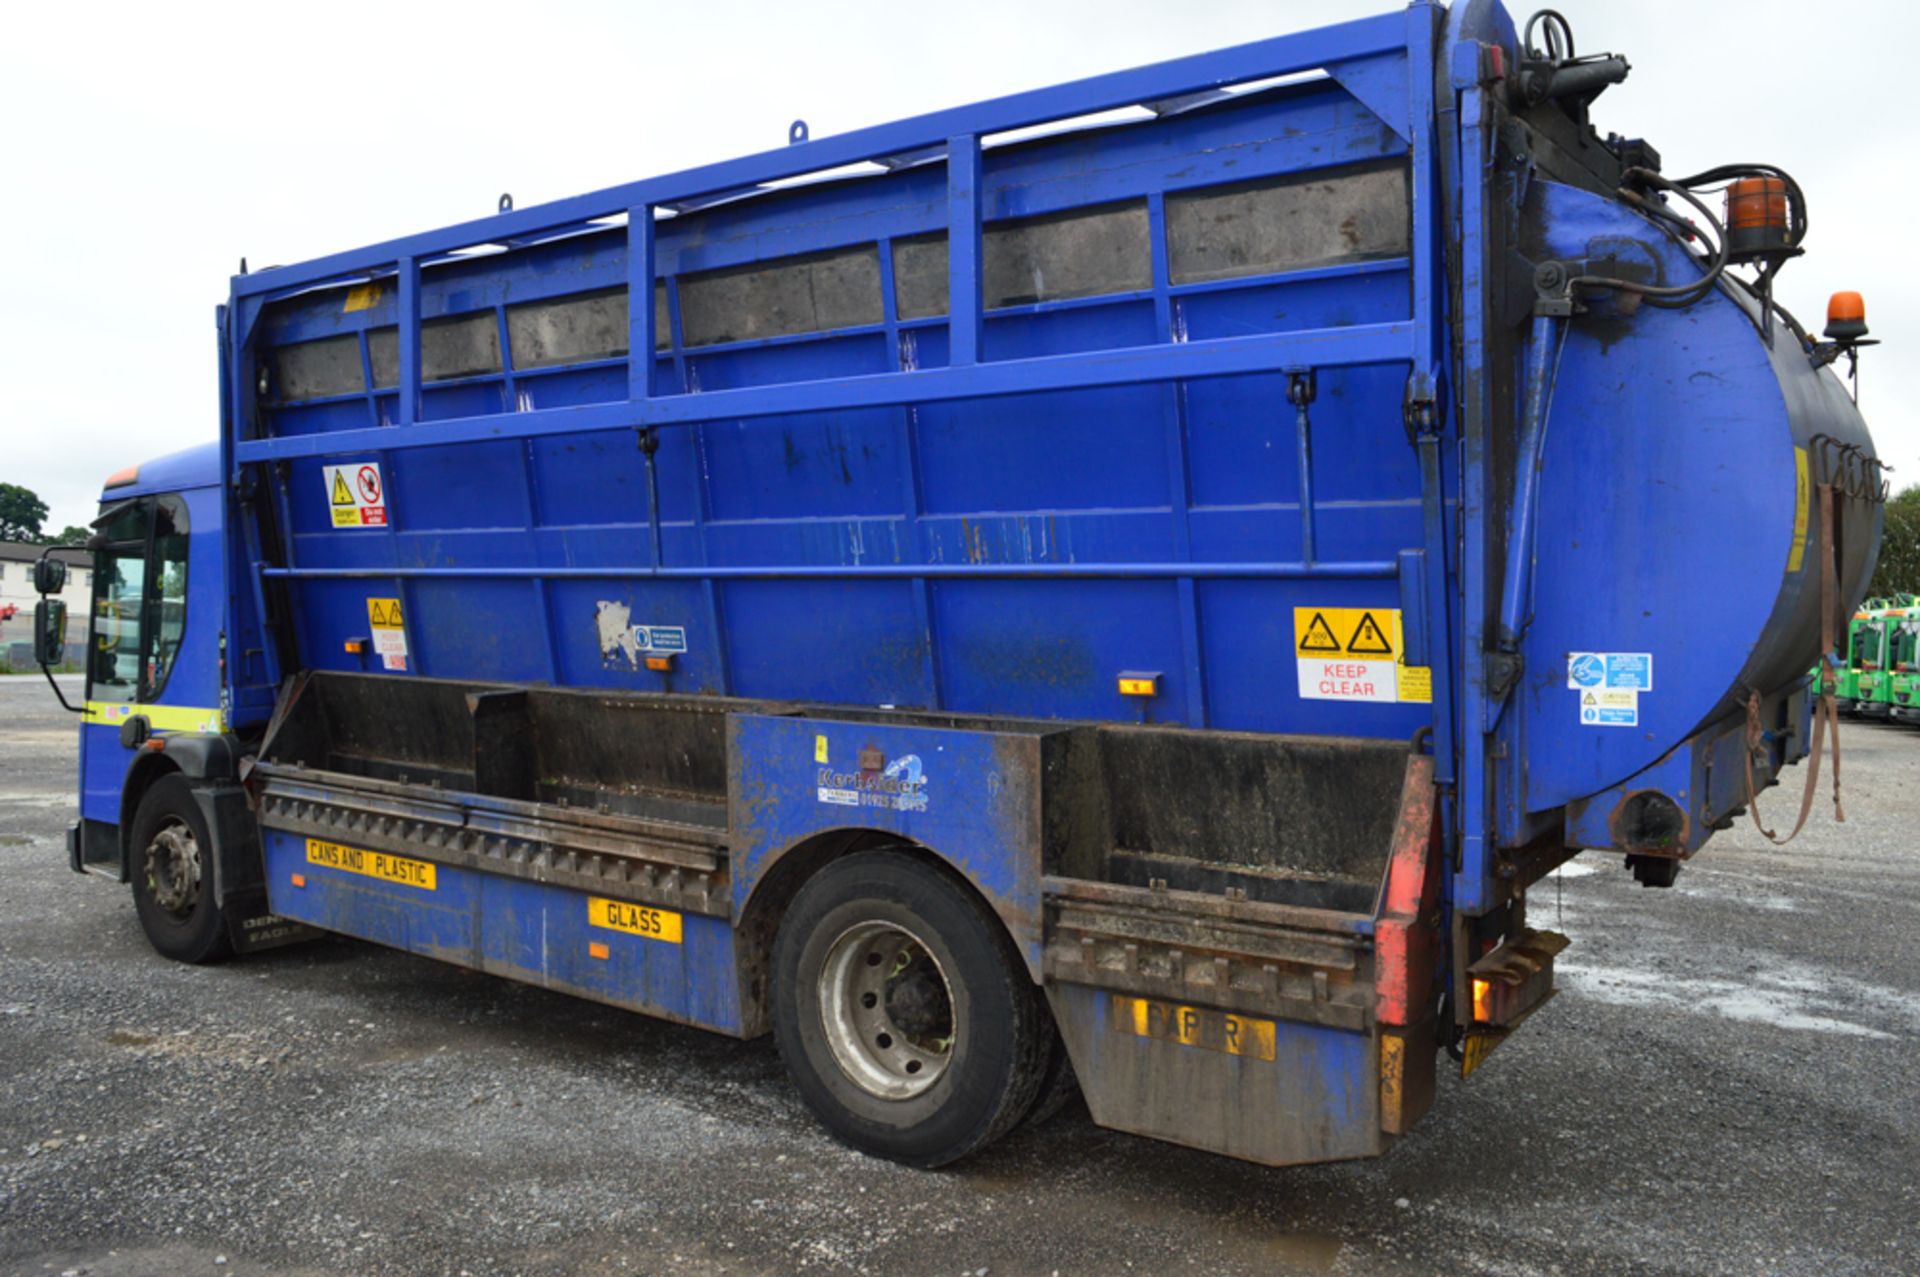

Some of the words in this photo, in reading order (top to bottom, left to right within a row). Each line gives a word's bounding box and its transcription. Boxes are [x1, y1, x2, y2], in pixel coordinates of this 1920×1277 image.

[1323, 664, 1367, 679] KEEP
[1319, 681, 1376, 696] CLEAR
[310, 842, 338, 864] CANS
[341, 848, 364, 870] AND
[376, 856, 427, 884] PLASTIC
[607, 903, 662, 934] GLASS
